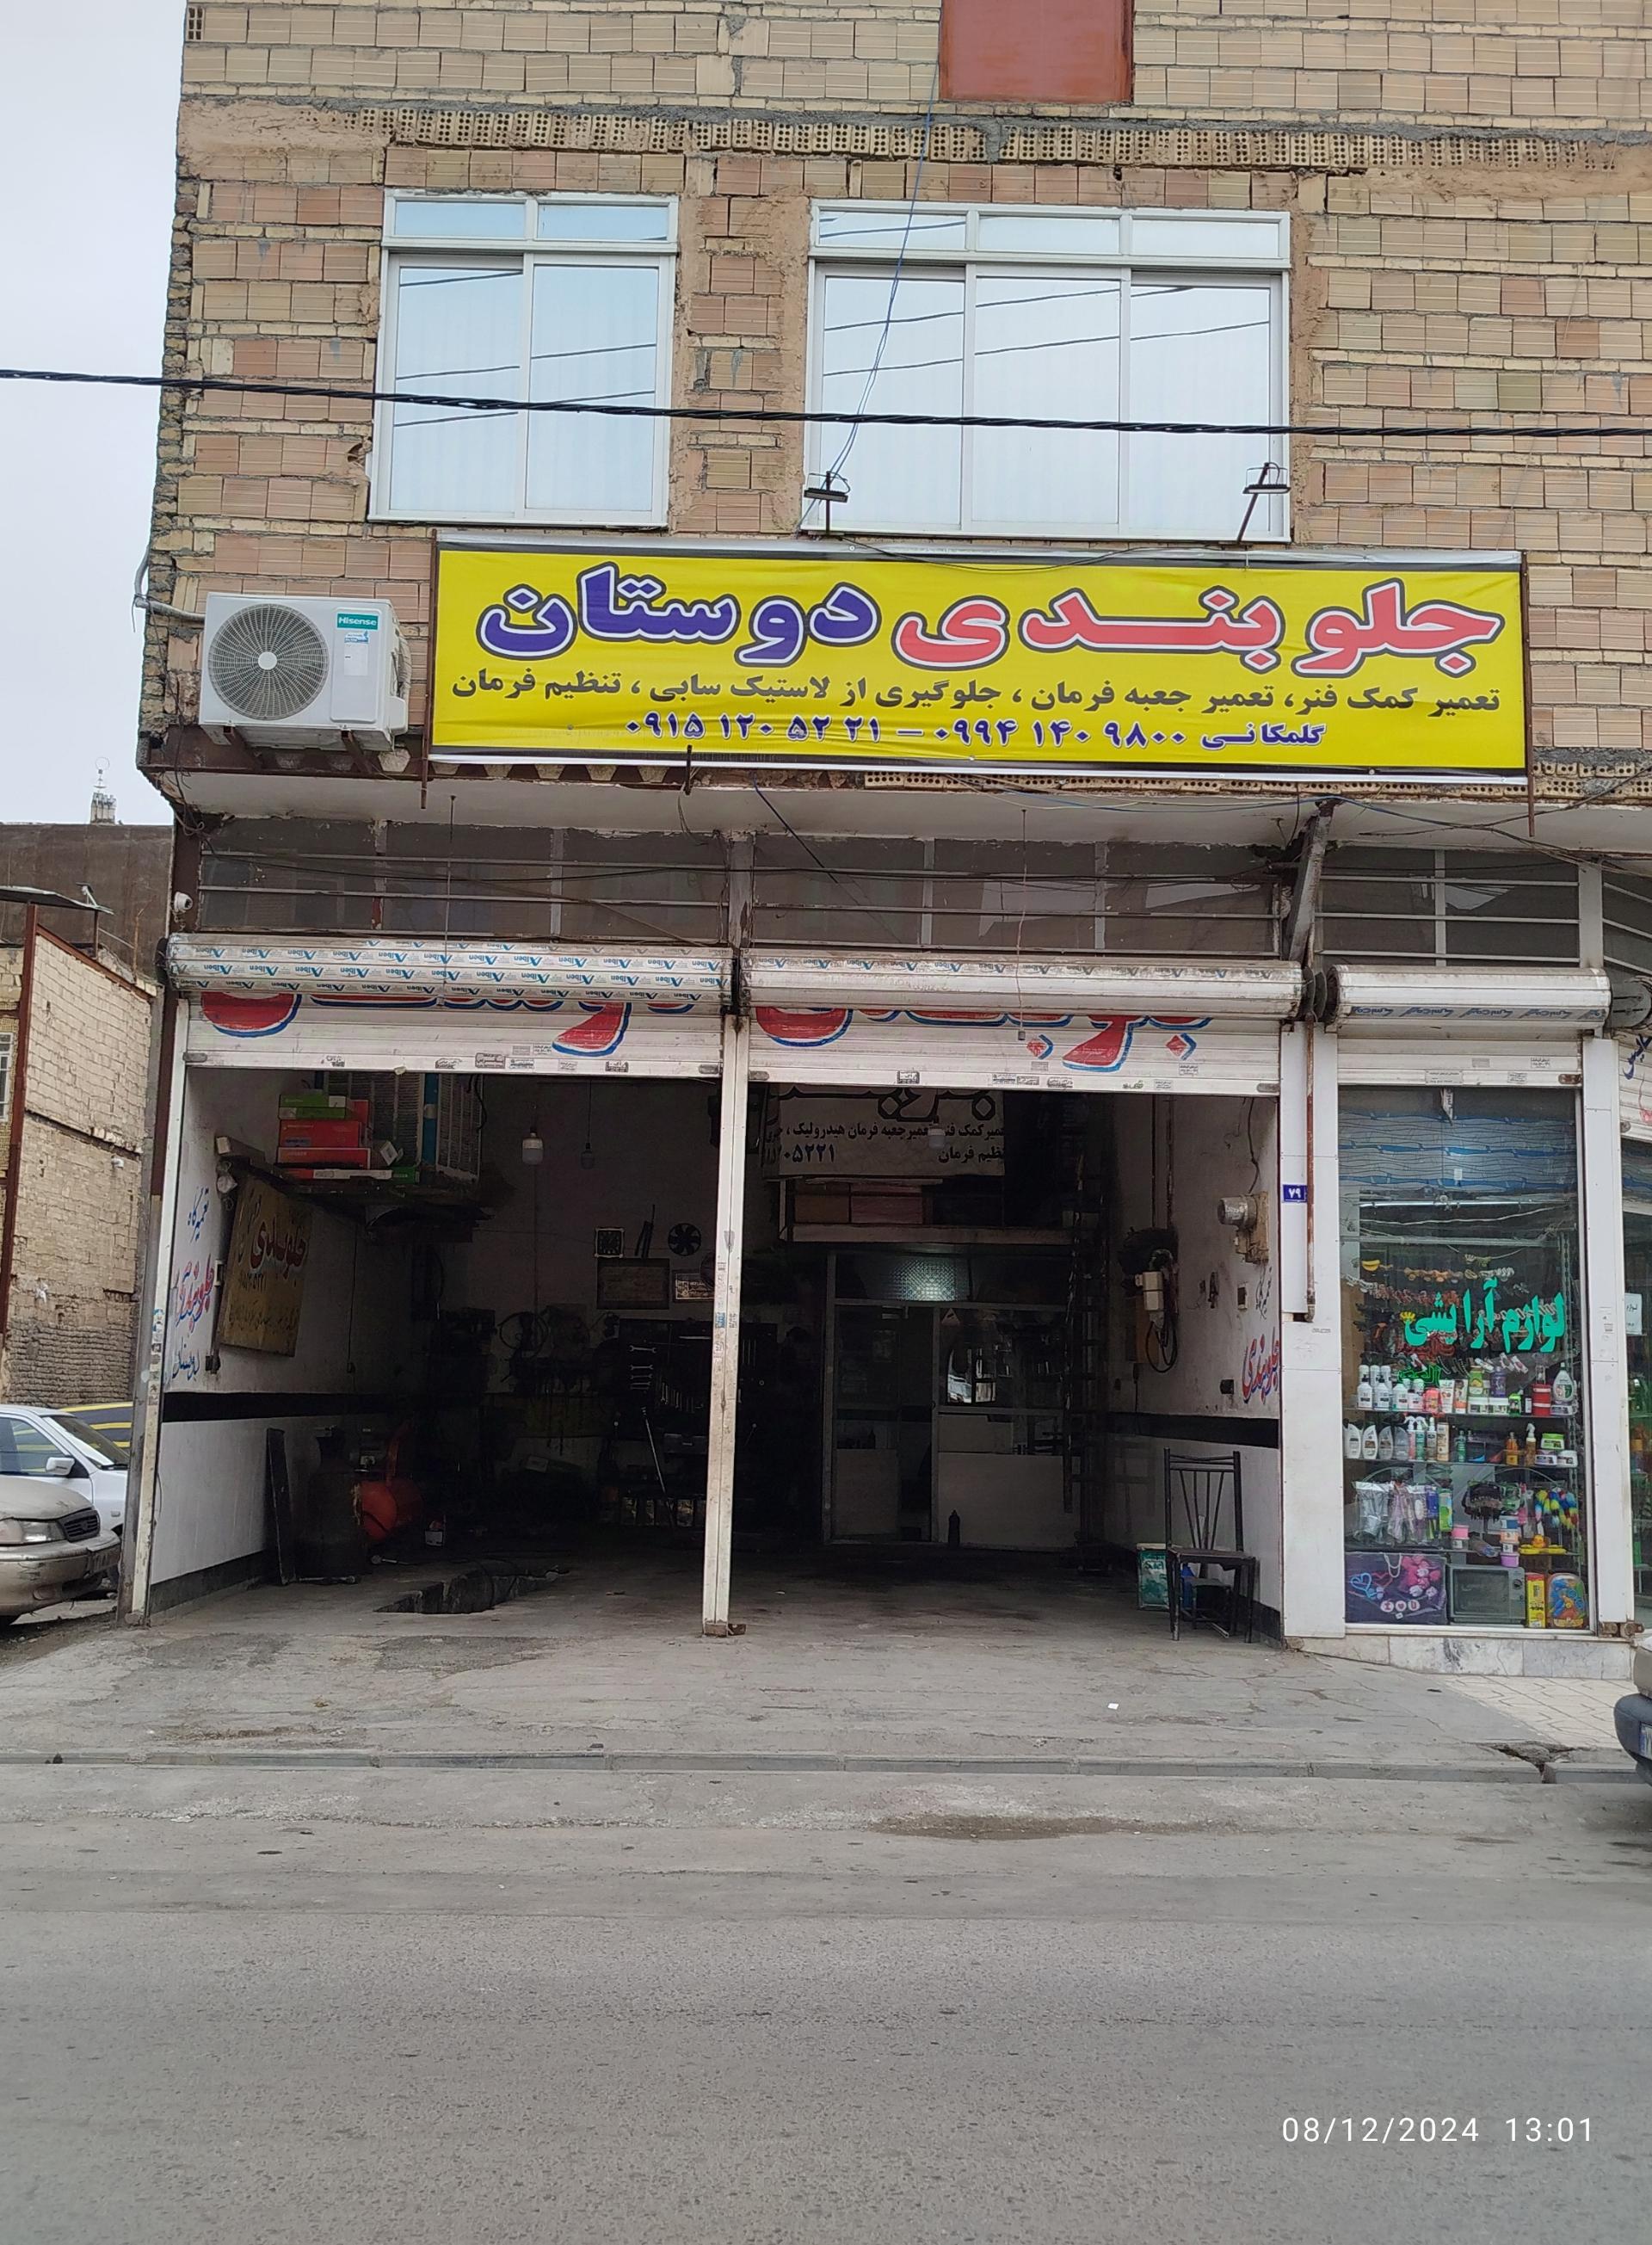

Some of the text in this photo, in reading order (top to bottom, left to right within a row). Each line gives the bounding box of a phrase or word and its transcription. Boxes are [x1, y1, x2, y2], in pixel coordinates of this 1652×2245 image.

[338, 616, 377, 626] Hisense
[476, 561, 882, 668] دوستان
[453, 667, 536, 700] فرمان
[545, 669, 622, 700] تنظیم
[650, 674, 722, 702] سابی
[730, 675, 830, 705] لاستیک
[839, 676, 866, 707] از
[1031, 680, 1115, 712] فرمان
[1124, 687, 1191, 712] جعبه
[1202, 685, 1274, 714] تعمیر
[1347, 688, 1418, 711] کمک
[1427, 689, 1500, 718] تعمیر
[625, 710, 706, 740] ۰۹۱۵
[719, 711, 774, 741] ۱۲۰
[934, 718, 1019, 746] ۰۹۹۴
[1032, 719, 1091, 747] ۱۴۰
[1103, 721, 1185, 749] ۹۸۰۰
[1200, 722, 1327, 749] گلمکانی
[1404, 1277, 1566, 1354] لوازم آرایشی
